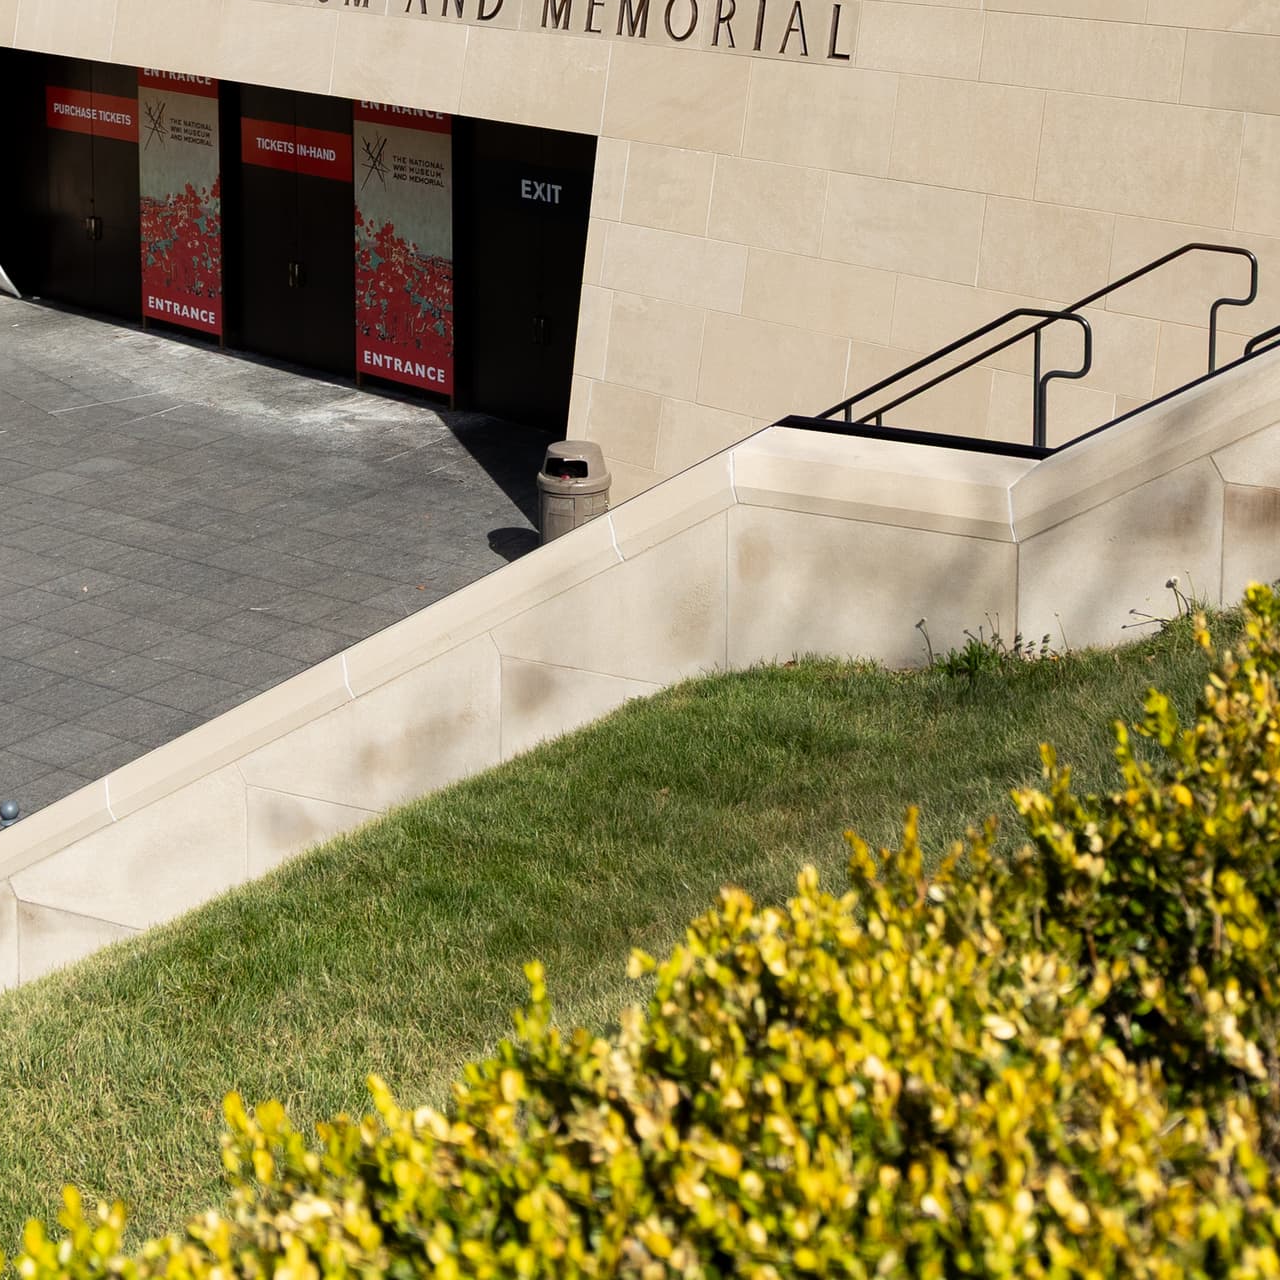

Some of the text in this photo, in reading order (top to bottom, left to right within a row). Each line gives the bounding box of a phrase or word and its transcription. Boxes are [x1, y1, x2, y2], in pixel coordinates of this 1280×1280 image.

[53, 102, 132, 126] PURCHASE TICKETS
[256, 137, 336, 162] TICKETS IN-HAND
[521, 178, 562, 204] EXIT
[148, 295, 216, 325] ENTRANCE
[363, 350, 446, 383] ENTRANCE
